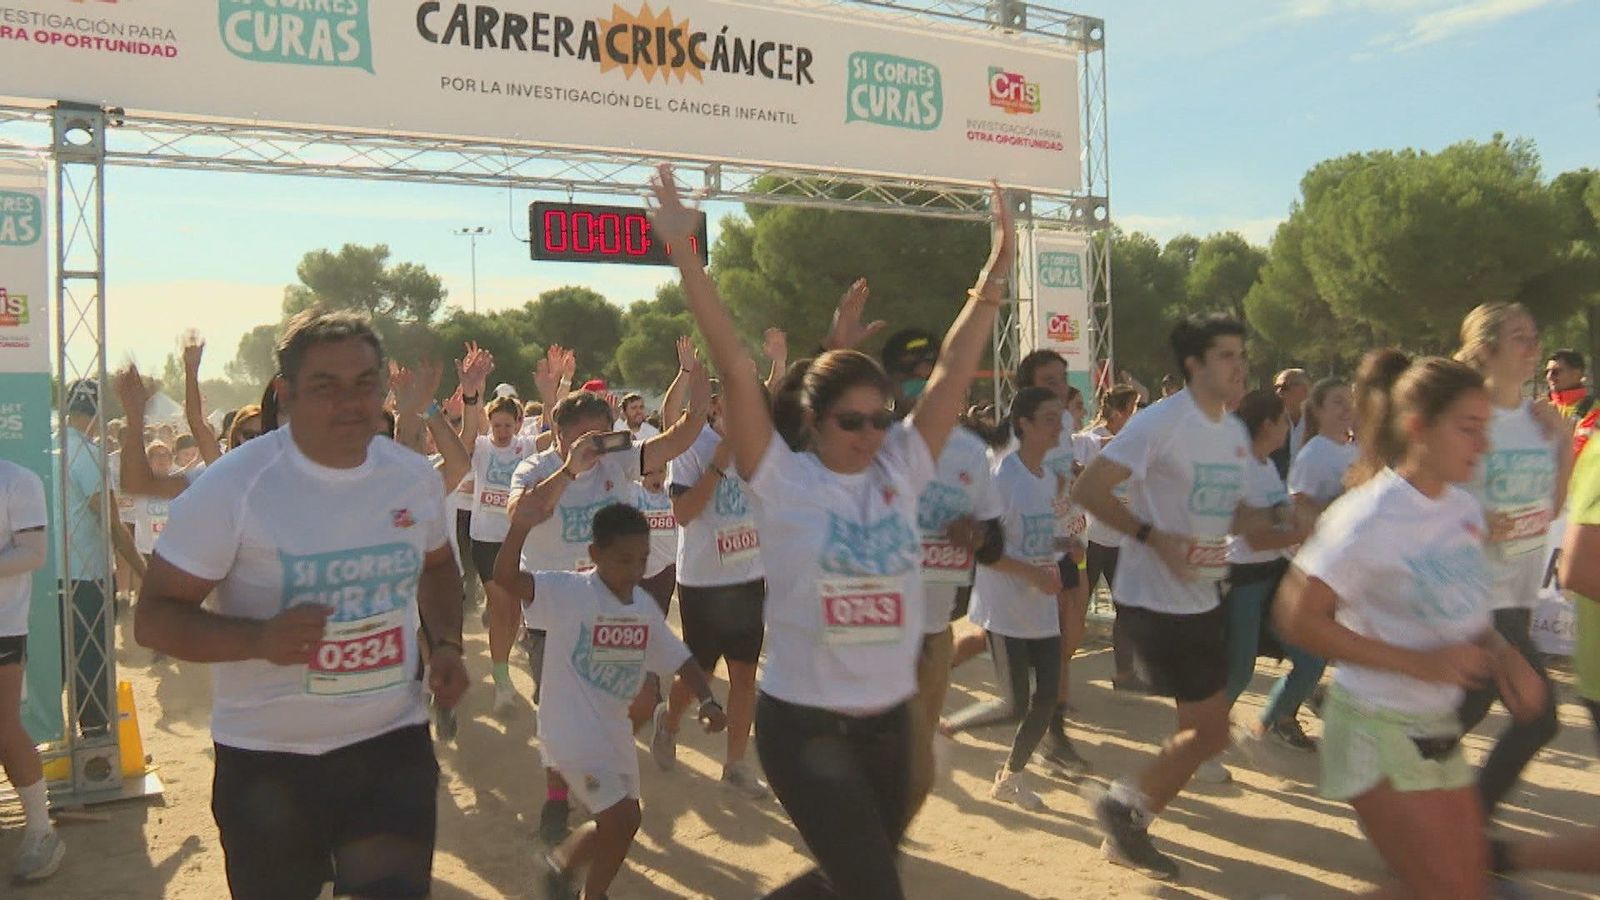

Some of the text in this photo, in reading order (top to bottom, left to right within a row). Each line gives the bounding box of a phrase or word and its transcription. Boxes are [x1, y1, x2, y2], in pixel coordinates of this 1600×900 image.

[0, 8, 177, 41] ESTIGACIÓN PARA
[224, 10, 361, 62] CURAS
[35, 30, 178, 58] OPORTUNIDAD
[853, 57, 935, 86] SI CORRES
[991, 73, 1037, 103] Cris
[440, 76, 799, 125] POR LA INVESTIGACIÓN DEL CÁNCER INFANTIL
[851, 84, 938, 125] CURAS
[967, 131, 1064, 151] OTRA OPORTUNIDAD
[294, 548, 417, 586] SI CORRES
[317, 634, 399, 671] 0334
[597, 626, 645, 646] 0090
